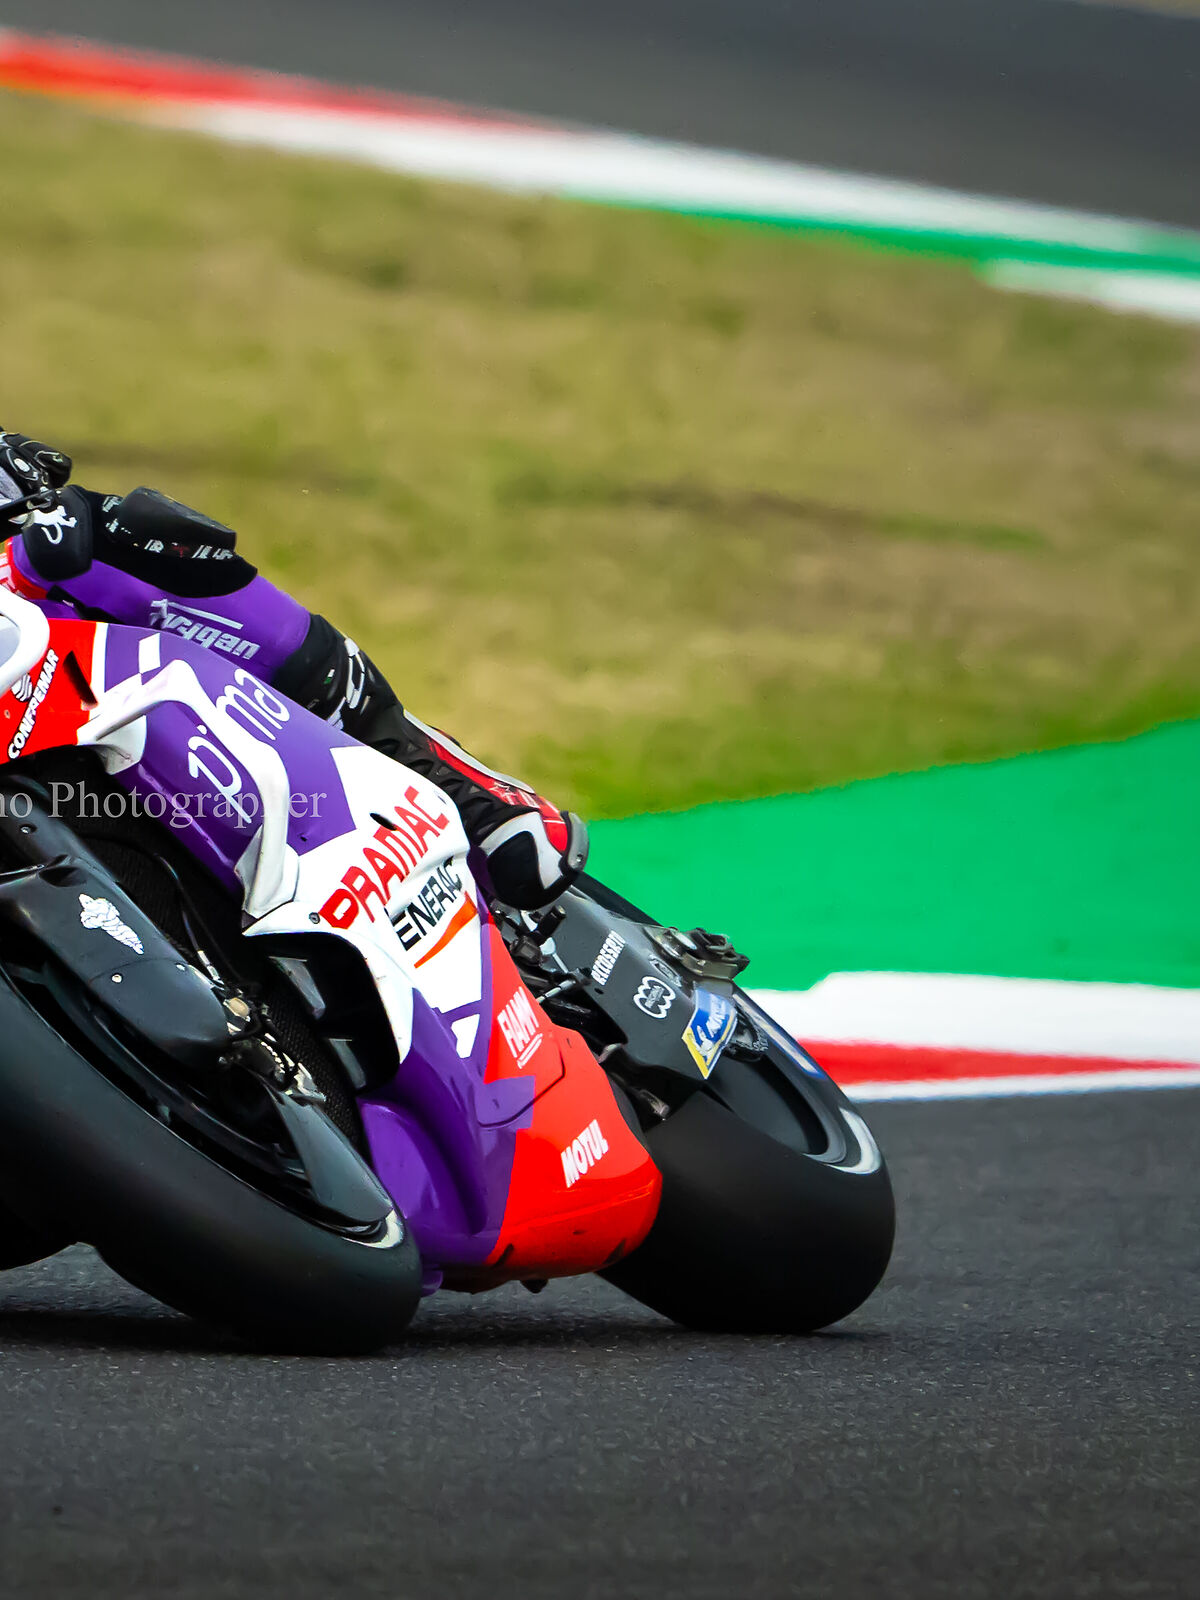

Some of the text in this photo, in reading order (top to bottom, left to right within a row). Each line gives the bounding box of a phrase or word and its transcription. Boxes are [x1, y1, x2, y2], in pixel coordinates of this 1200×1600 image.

[8, 649, 60, 759] CONFREMAR
[187, 668, 291, 824] pma
[318, 785, 450, 930] PRAMAC
[389, 858, 464, 952] ENERAC
[497, 986, 540, 1059] FIAMM
[560, 1119, 610, 1188] MOTUL
